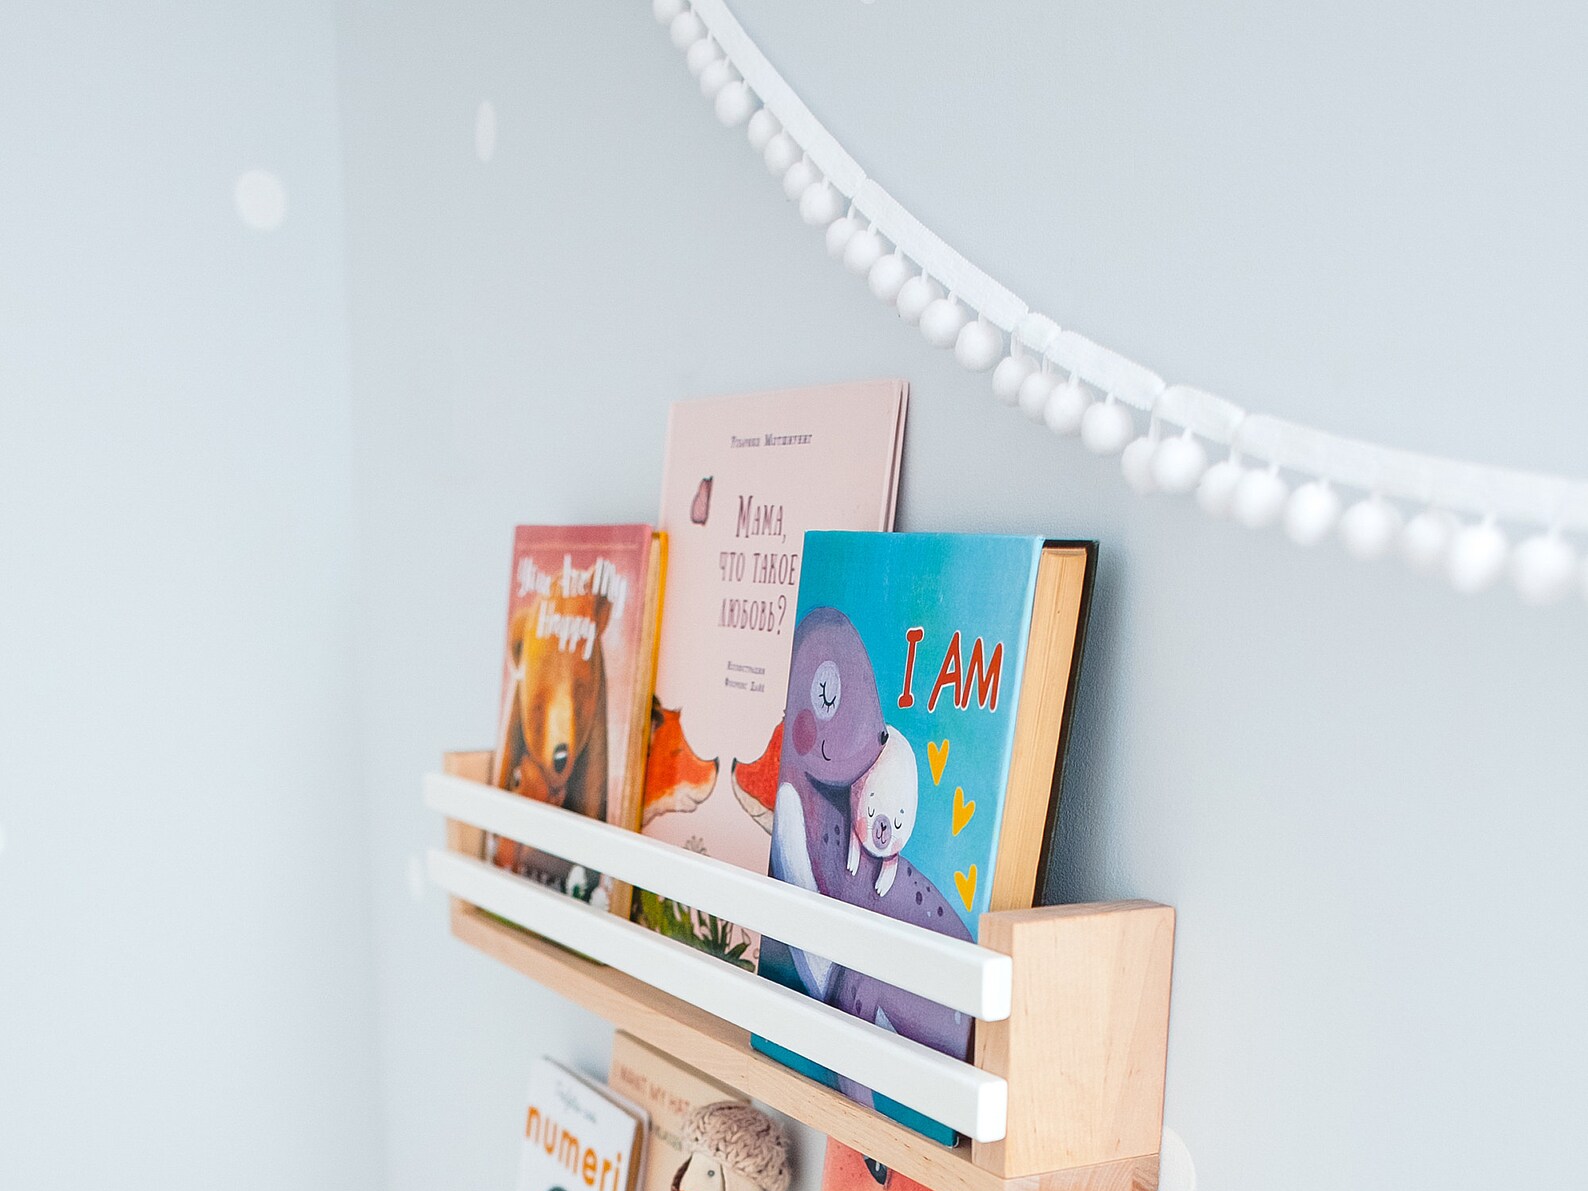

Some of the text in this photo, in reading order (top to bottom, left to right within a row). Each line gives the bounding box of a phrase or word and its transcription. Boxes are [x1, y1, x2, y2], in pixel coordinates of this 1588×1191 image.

[719, 551, 799, 586] ЧТО ТАКОЕ
[718, 594, 787, 635] ЛЮБОВЬ?
[898, 626, 1004, 713] I AM
